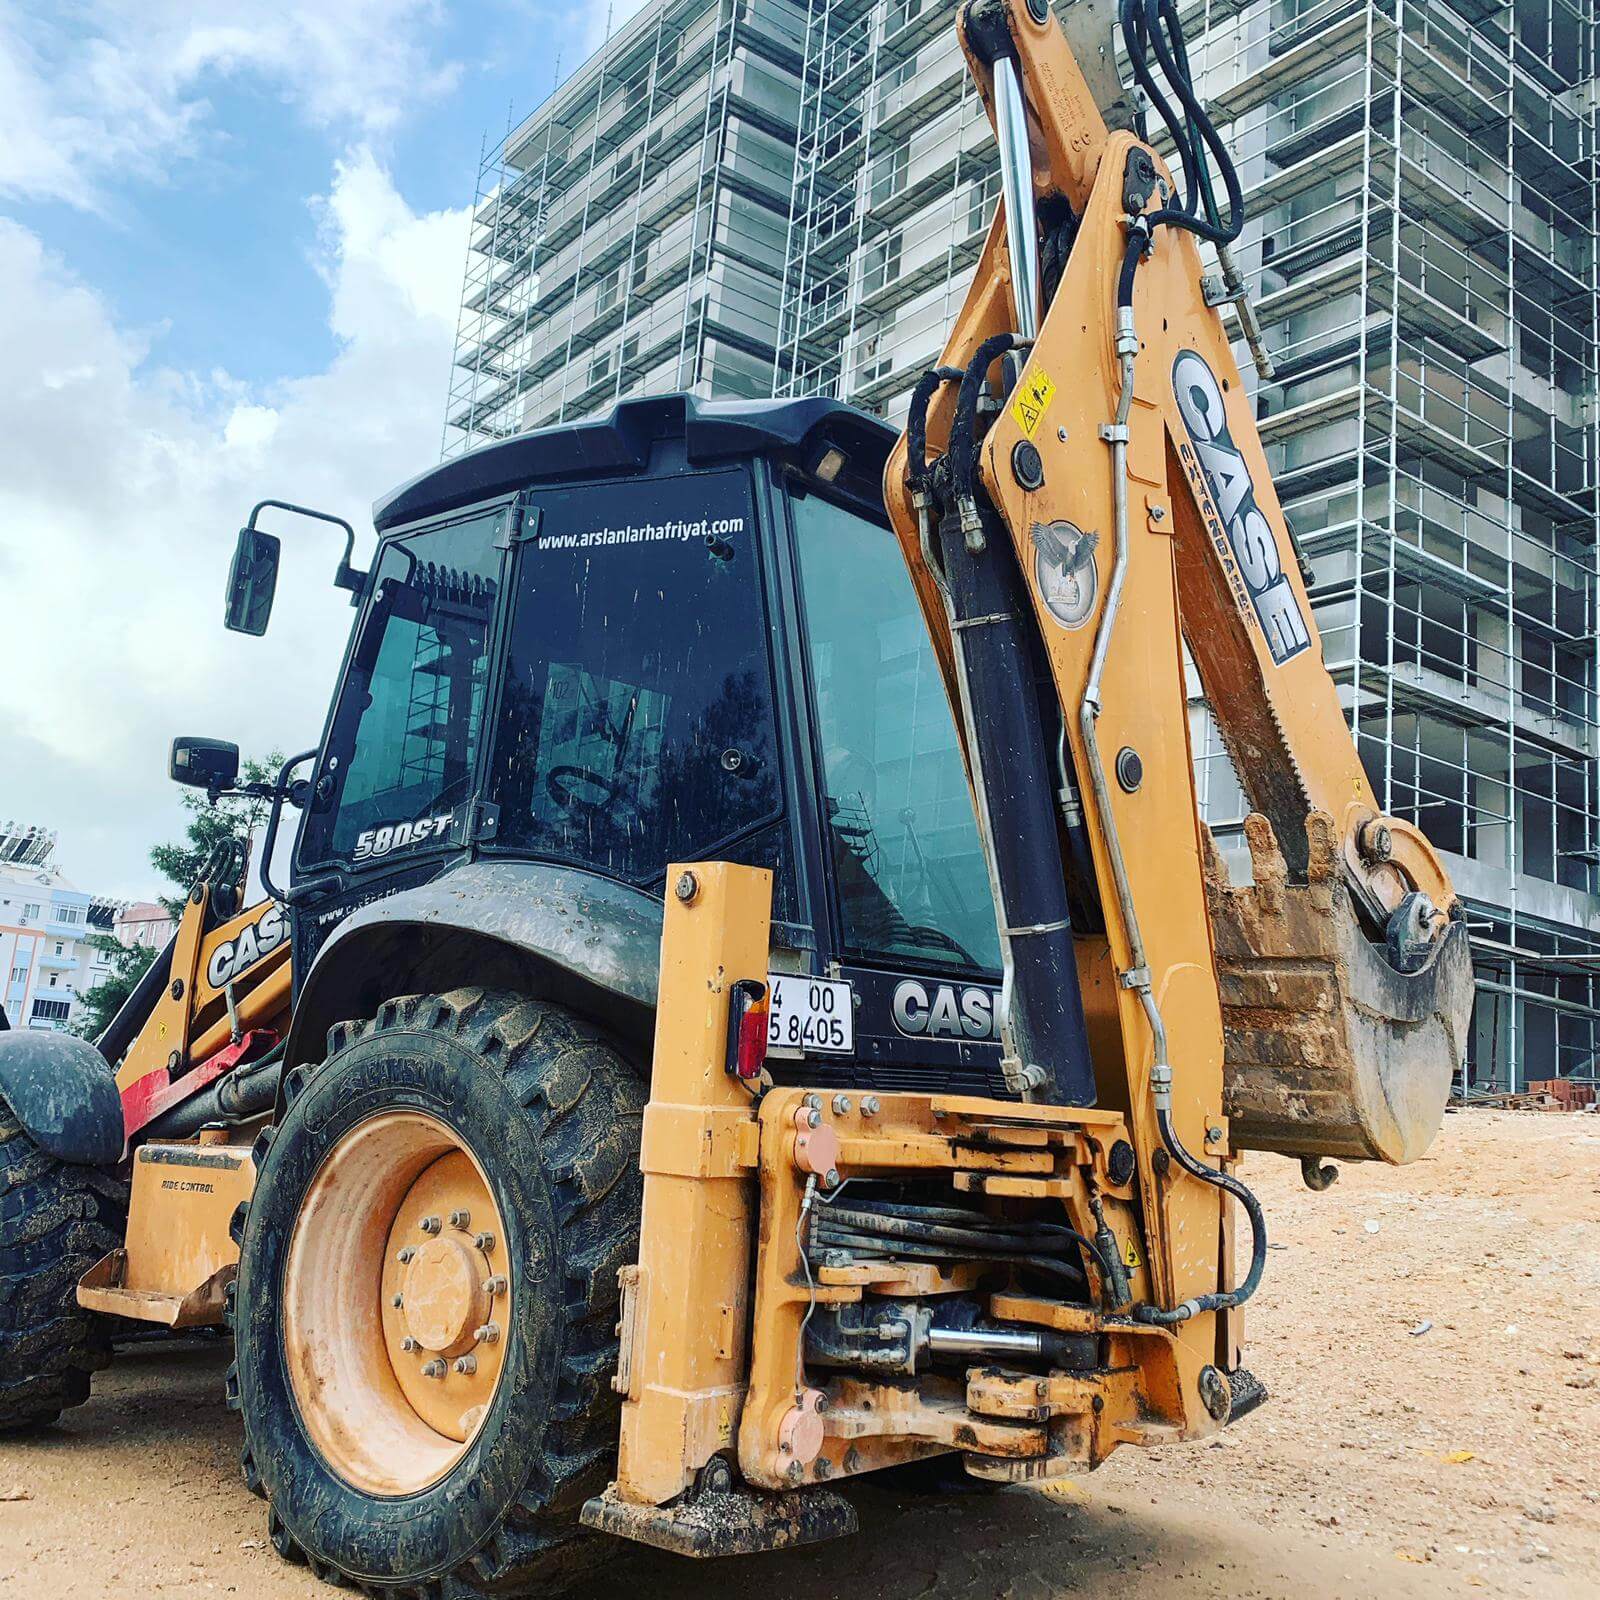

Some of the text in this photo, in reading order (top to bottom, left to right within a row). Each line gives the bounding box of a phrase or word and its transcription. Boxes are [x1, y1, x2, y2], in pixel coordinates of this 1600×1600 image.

[1172, 350, 1311, 668] CASE
[538, 518, 744, 550] www.arslanlarhafriyat.com
[207, 905, 292, 988] CAS
[809, 985, 834, 1013] 00
[892, 979, 1002, 1038] CAS
[161, 1180, 214, 1193] RIDE CONTROL
